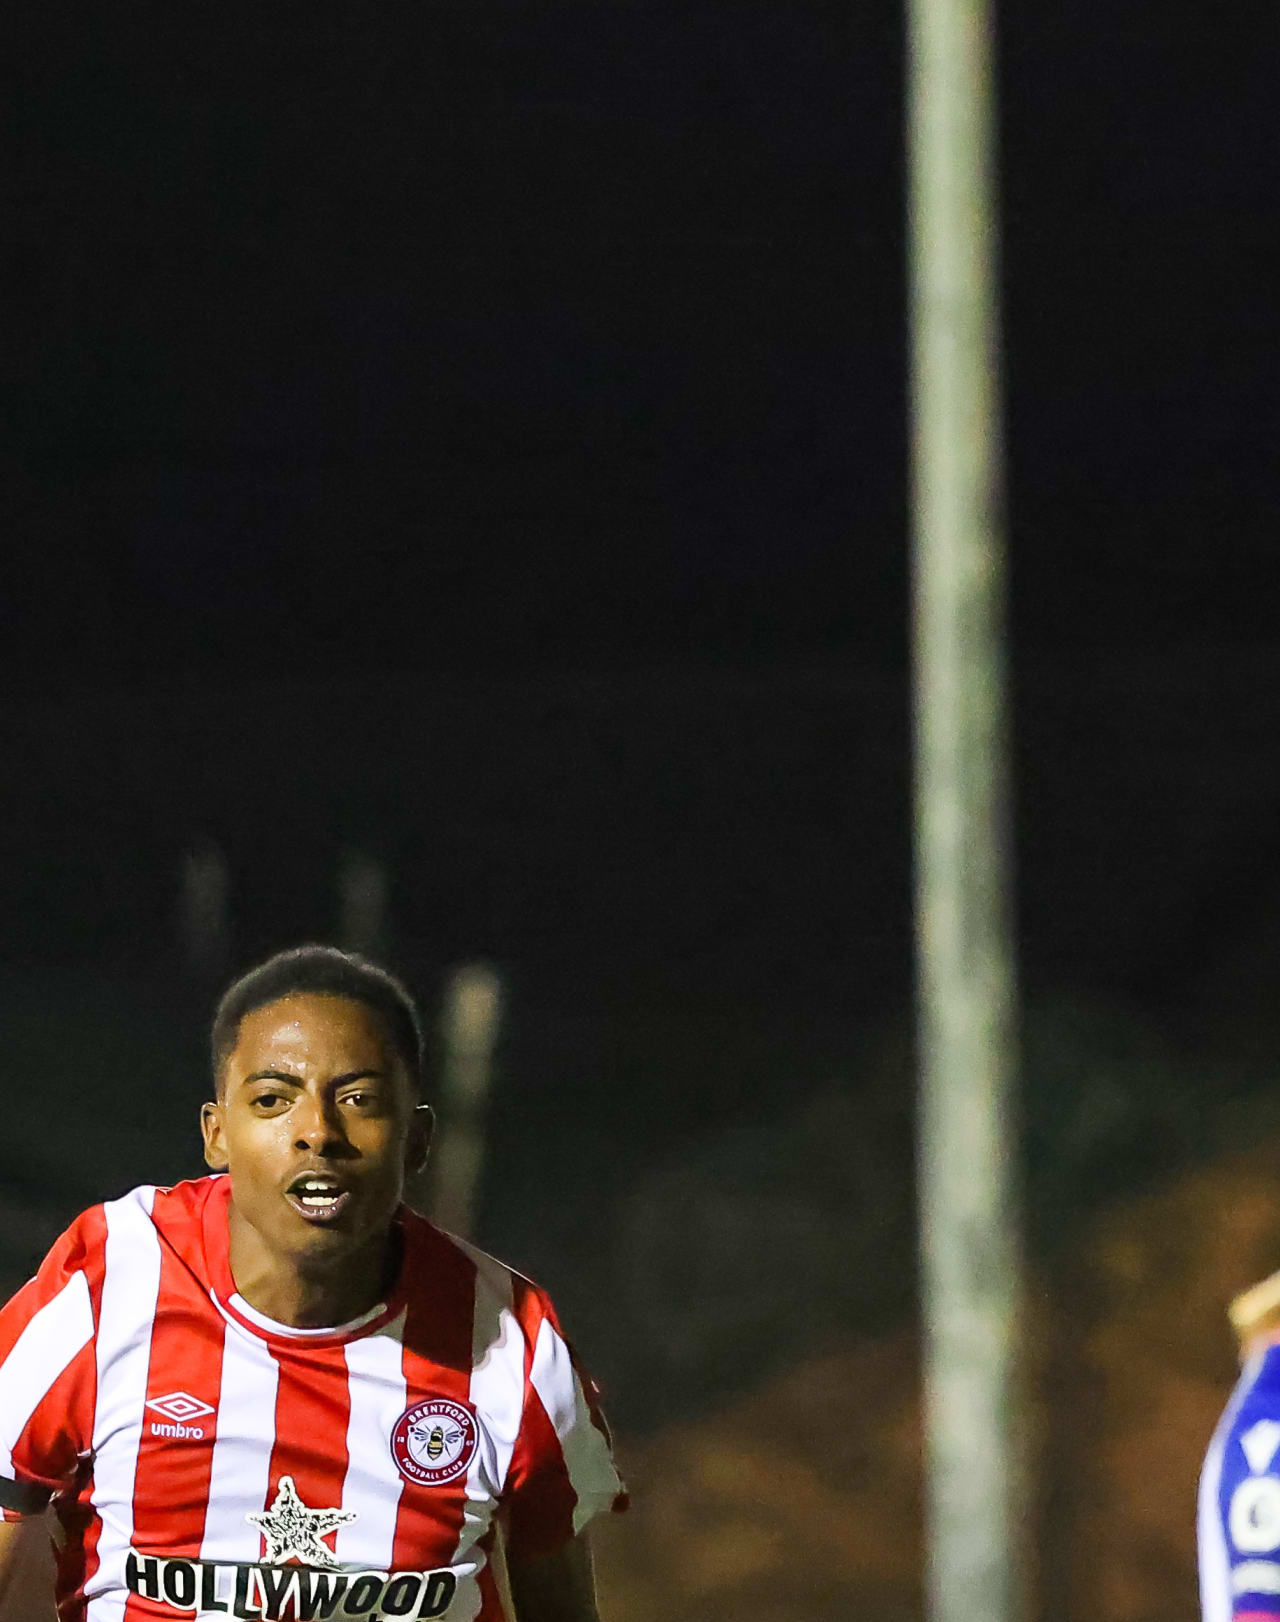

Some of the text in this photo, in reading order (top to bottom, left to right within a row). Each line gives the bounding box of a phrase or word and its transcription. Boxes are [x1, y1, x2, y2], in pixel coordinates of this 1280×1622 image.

[408, 1405, 470, 1426] BRENTFORD
[151, 1422, 204, 1440] umbro
[402, 1458, 463, 1479] FOOTBALL CLUB
[125, 1551, 457, 1622] HOLLYWOOD
